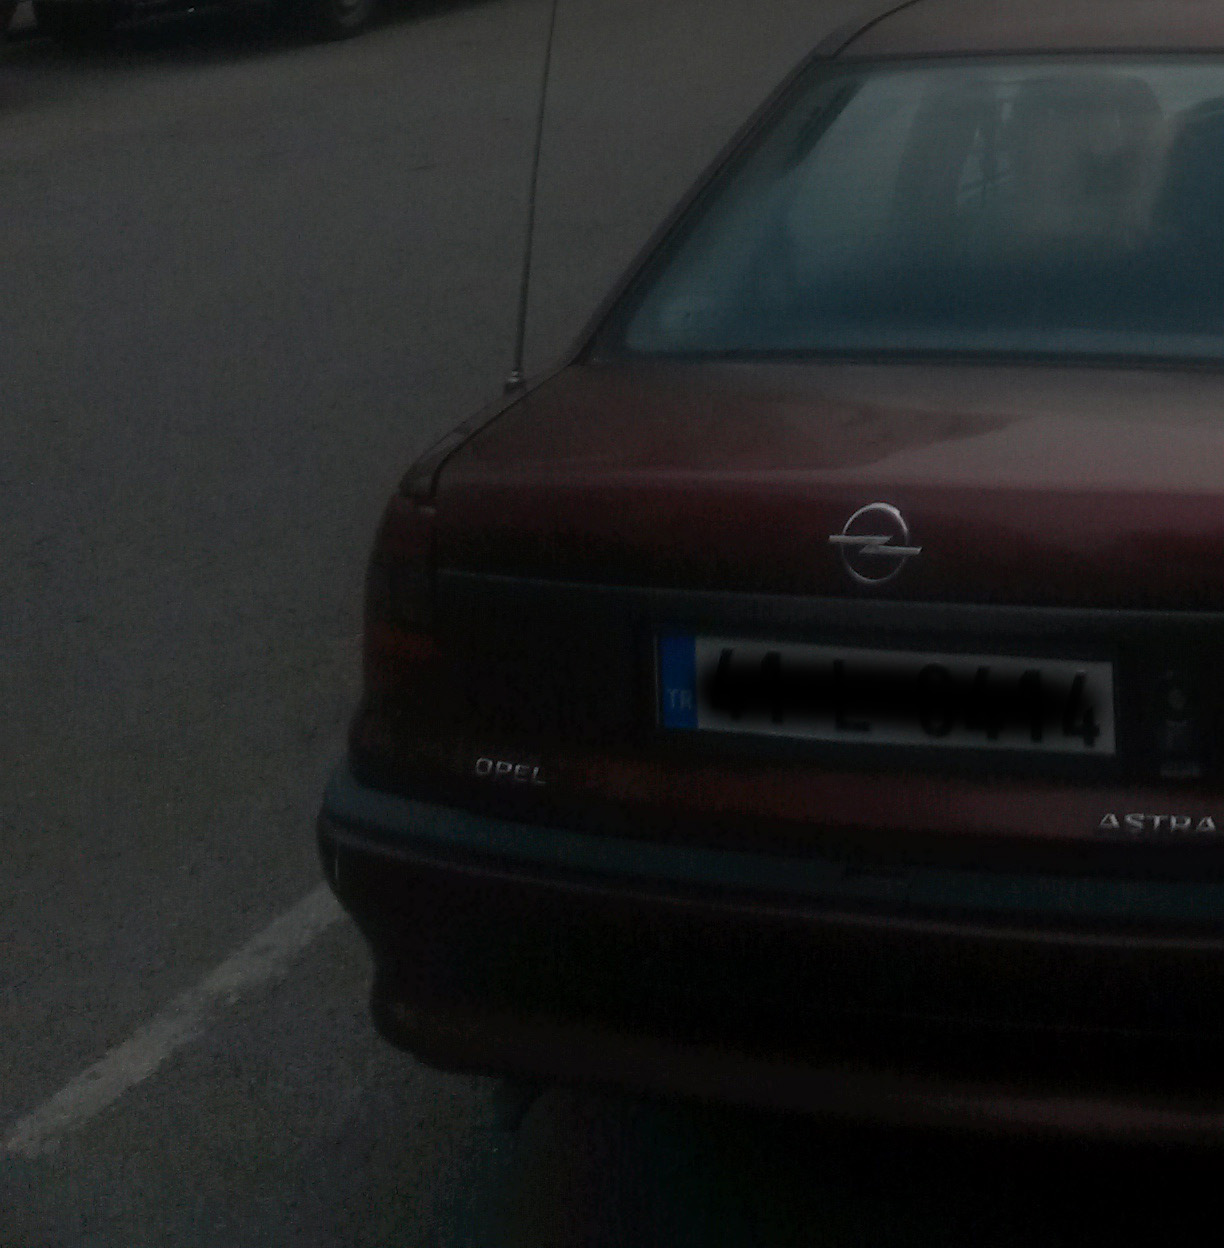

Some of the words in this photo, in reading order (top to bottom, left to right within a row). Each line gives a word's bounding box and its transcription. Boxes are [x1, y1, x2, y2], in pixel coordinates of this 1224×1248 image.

[669, 688, 694, 711] TR
[475, 757, 546, 784] OPEL
[1098, 812, 1217, 835] ASTRA
